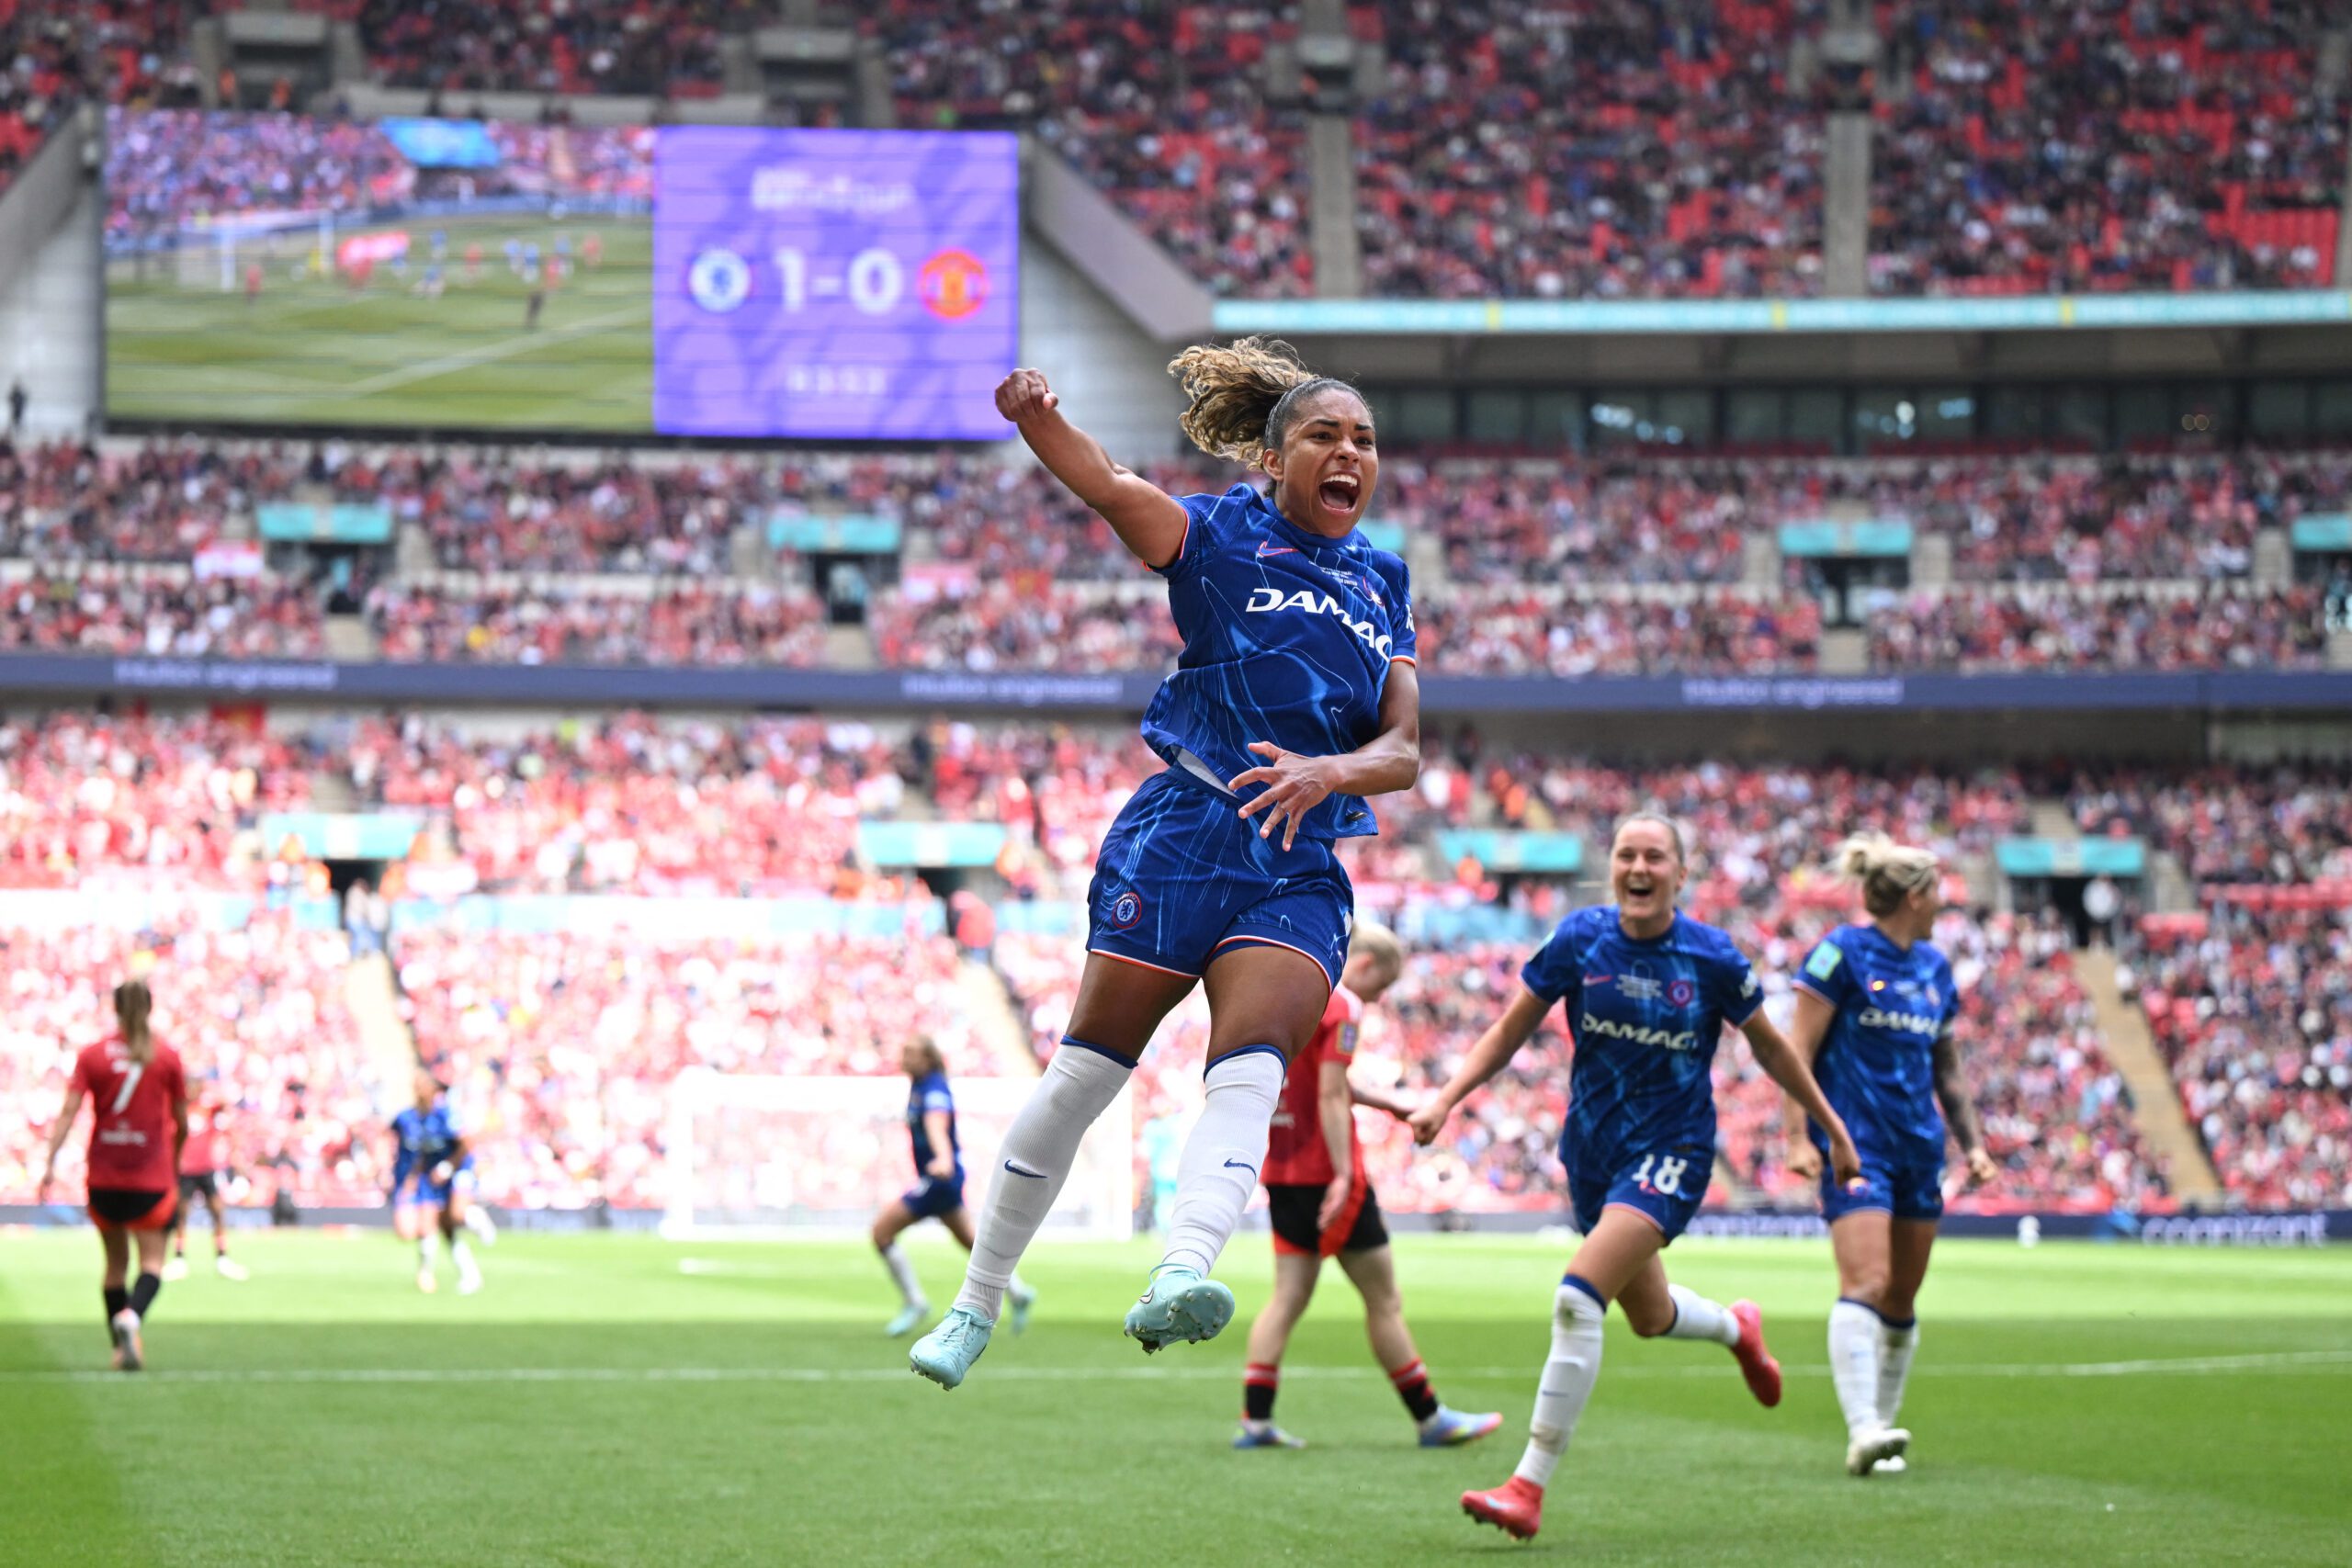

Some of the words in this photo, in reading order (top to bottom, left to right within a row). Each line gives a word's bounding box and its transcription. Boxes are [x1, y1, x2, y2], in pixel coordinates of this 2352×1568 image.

[775, 246, 904, 316] 1-0
[1581, 1012, 1698, 1050] DAMAC
[112, 1059, 141, 1114] 7
[1632, 1154, 1688, 1194] 18
